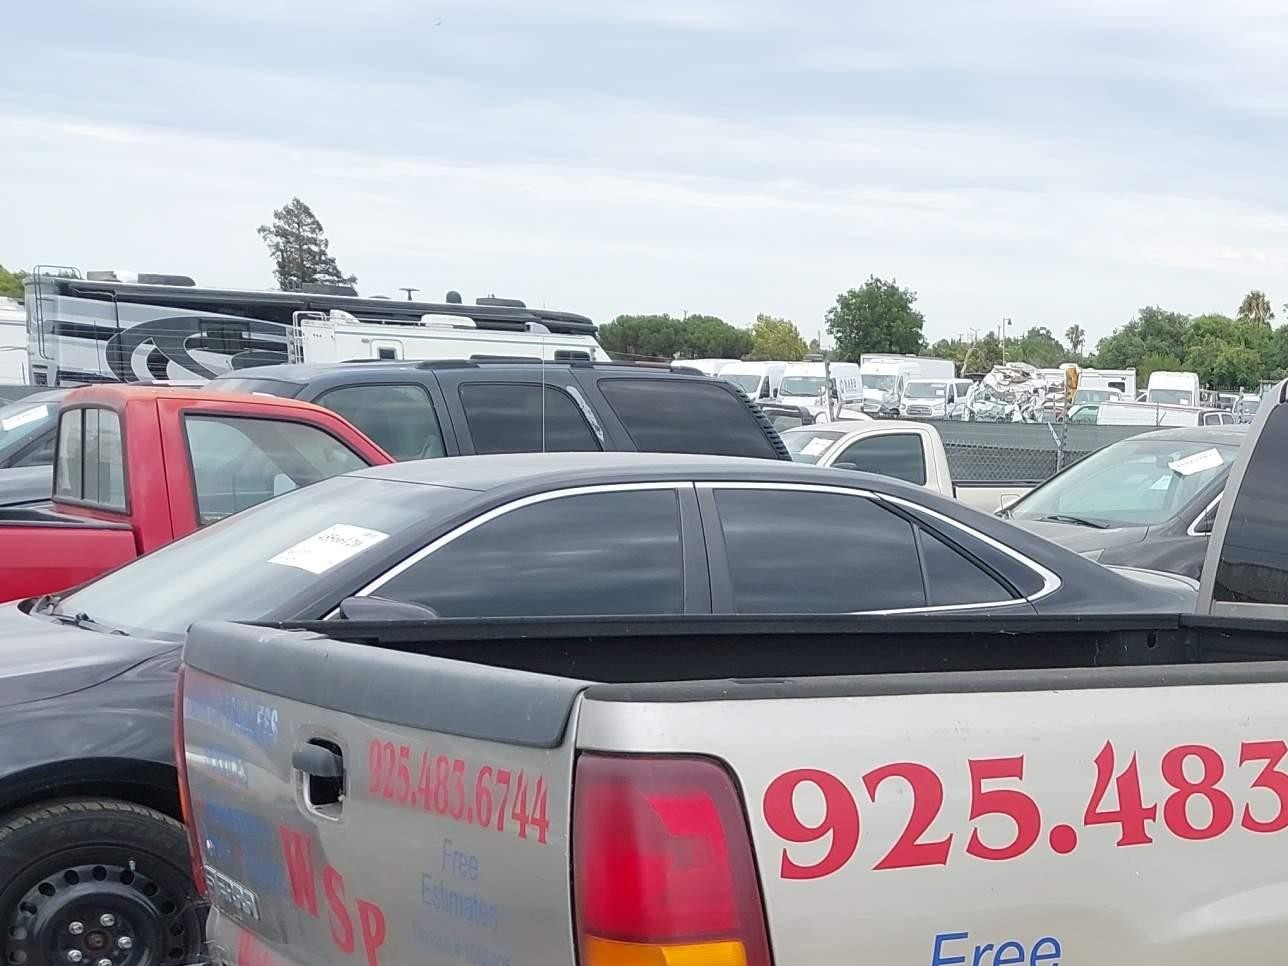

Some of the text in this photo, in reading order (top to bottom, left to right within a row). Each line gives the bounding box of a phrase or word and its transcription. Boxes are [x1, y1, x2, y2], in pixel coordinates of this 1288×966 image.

[368, 738, 550, 845] 925.483.6744
[442, 838, 479, 881] Free
[421, 873, 498, 931] Estimates
